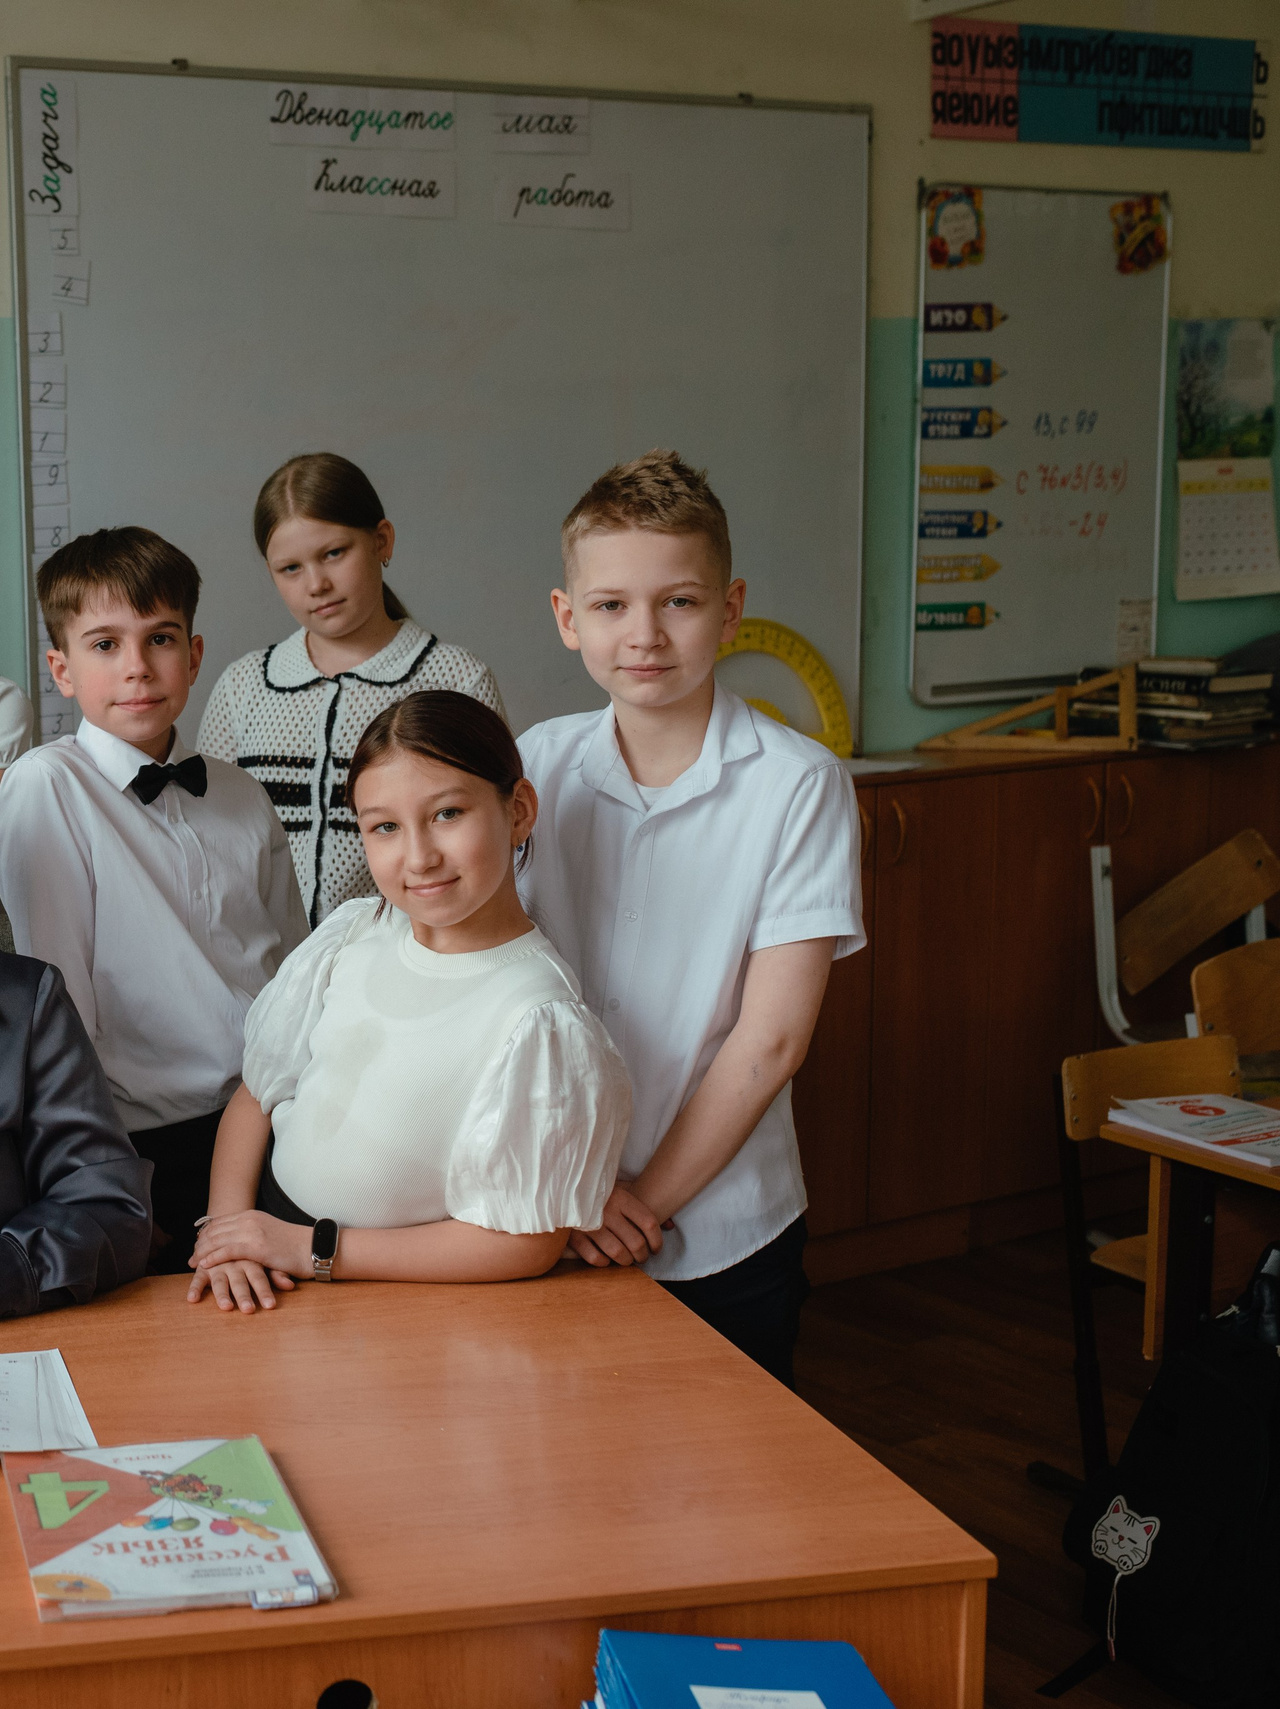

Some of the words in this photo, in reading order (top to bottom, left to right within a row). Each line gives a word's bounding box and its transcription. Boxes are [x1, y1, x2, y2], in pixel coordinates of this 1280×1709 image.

[270, 89, 455, 142] Двенадцатое
[501, 112, 578, 135] мая
[28, 82, 73, 213] Задача
[314, 158, 441, 199] Классная
[513, 173, 615, 218] работа
[57, 229, 72, 250] 5
[60, 275, 74, 297] 4
[929, 309, 967, 327] ИЗО
[38, 331, 51, 353] 3
[38, 381, 53, 404] 2
[38, 431, 49, 453] 1
[48, 464, 60, 486] 9
[50, 526, 62, 548] 8
[52, 713, 64, 734] 3
[19, 1471, 110, 1529] 4
[139, 1544, 294, 1568] Русский
